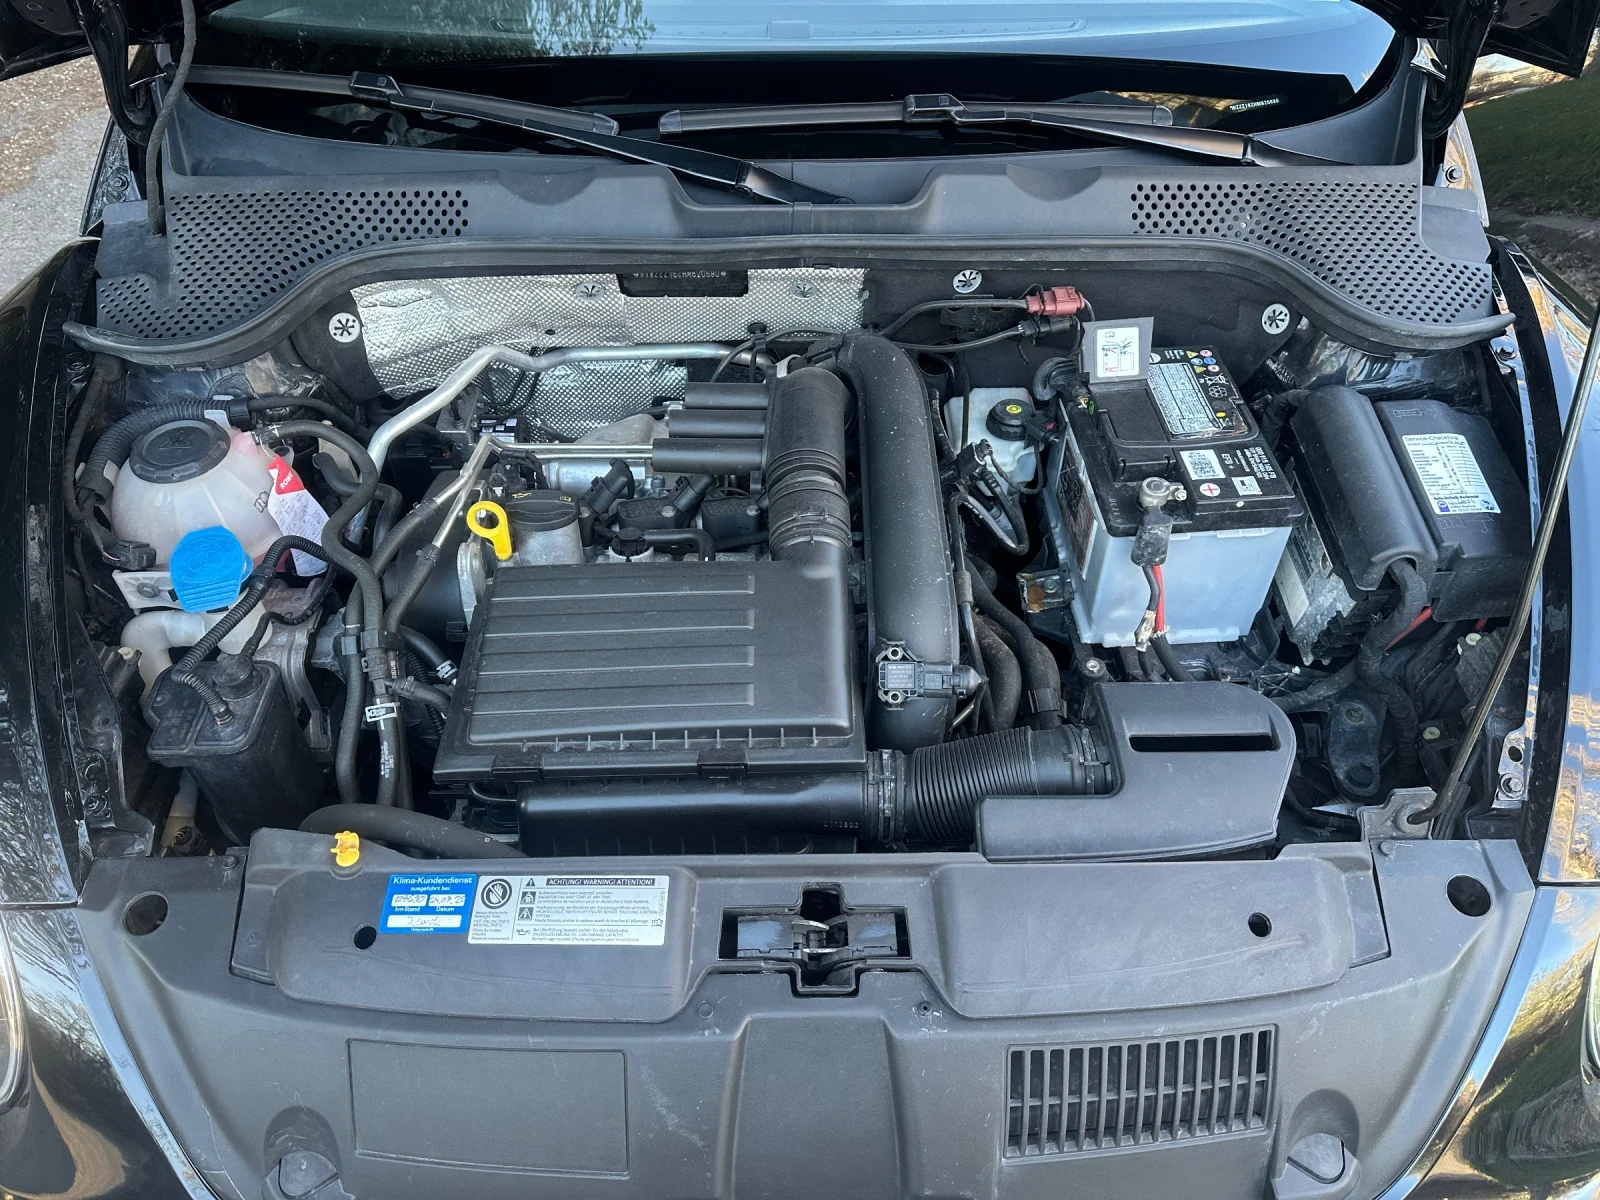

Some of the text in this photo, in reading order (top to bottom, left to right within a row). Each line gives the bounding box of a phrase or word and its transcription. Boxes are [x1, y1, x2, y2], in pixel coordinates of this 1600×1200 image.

[1221, 453, 1233, 465] EFB
[279, 470, 294, 490] ROWE
[393, 876, 473, 884] Klima-Kundendienst
[548, 878, 654, 886] ACHTUNG! WARNING! ATTENTION!
